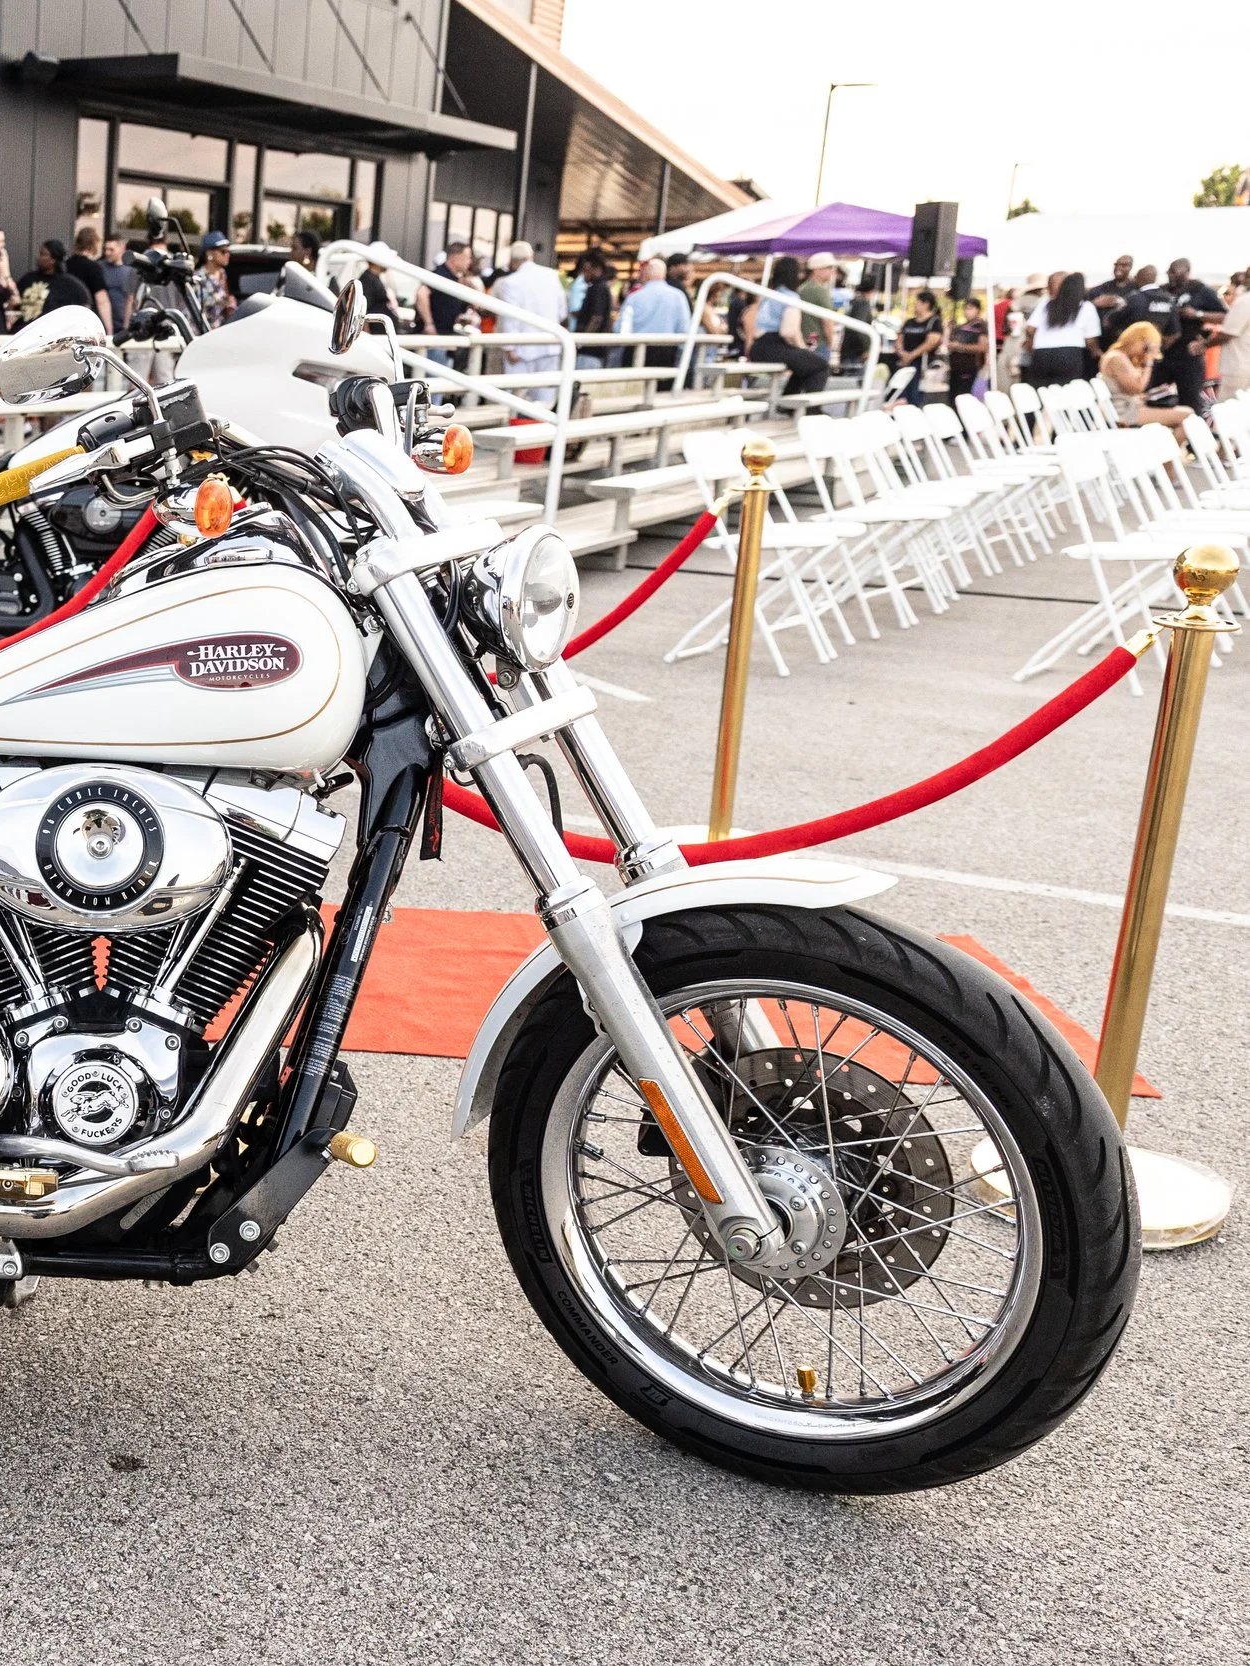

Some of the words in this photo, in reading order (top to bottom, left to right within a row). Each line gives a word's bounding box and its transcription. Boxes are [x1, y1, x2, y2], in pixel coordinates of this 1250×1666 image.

[198, 643, 276, 661] HARLEY
[189, 657, 286, 678] DAVIDSON
[208, 673, 271, 682] MOTORCYCLES
[42, 818, 56, 835] 96
[56, 786, 103, 812] CUBIC
[113, 787, 158, 832] INCHES
[43, 864, 72, 897] DYNA
[82, 896, 112, 907] LOW
[121, 859, 160, 901] RIDER
[67, 1072, 92, 1093] GOOD
[100, 1072, 125, 1092] LUCK
[80, 1116, 124, 1138] FUCKERS
[523, 1183, 551, 1263] MICHELIN
[556, 1289, 619, 1366] COMMANDER
